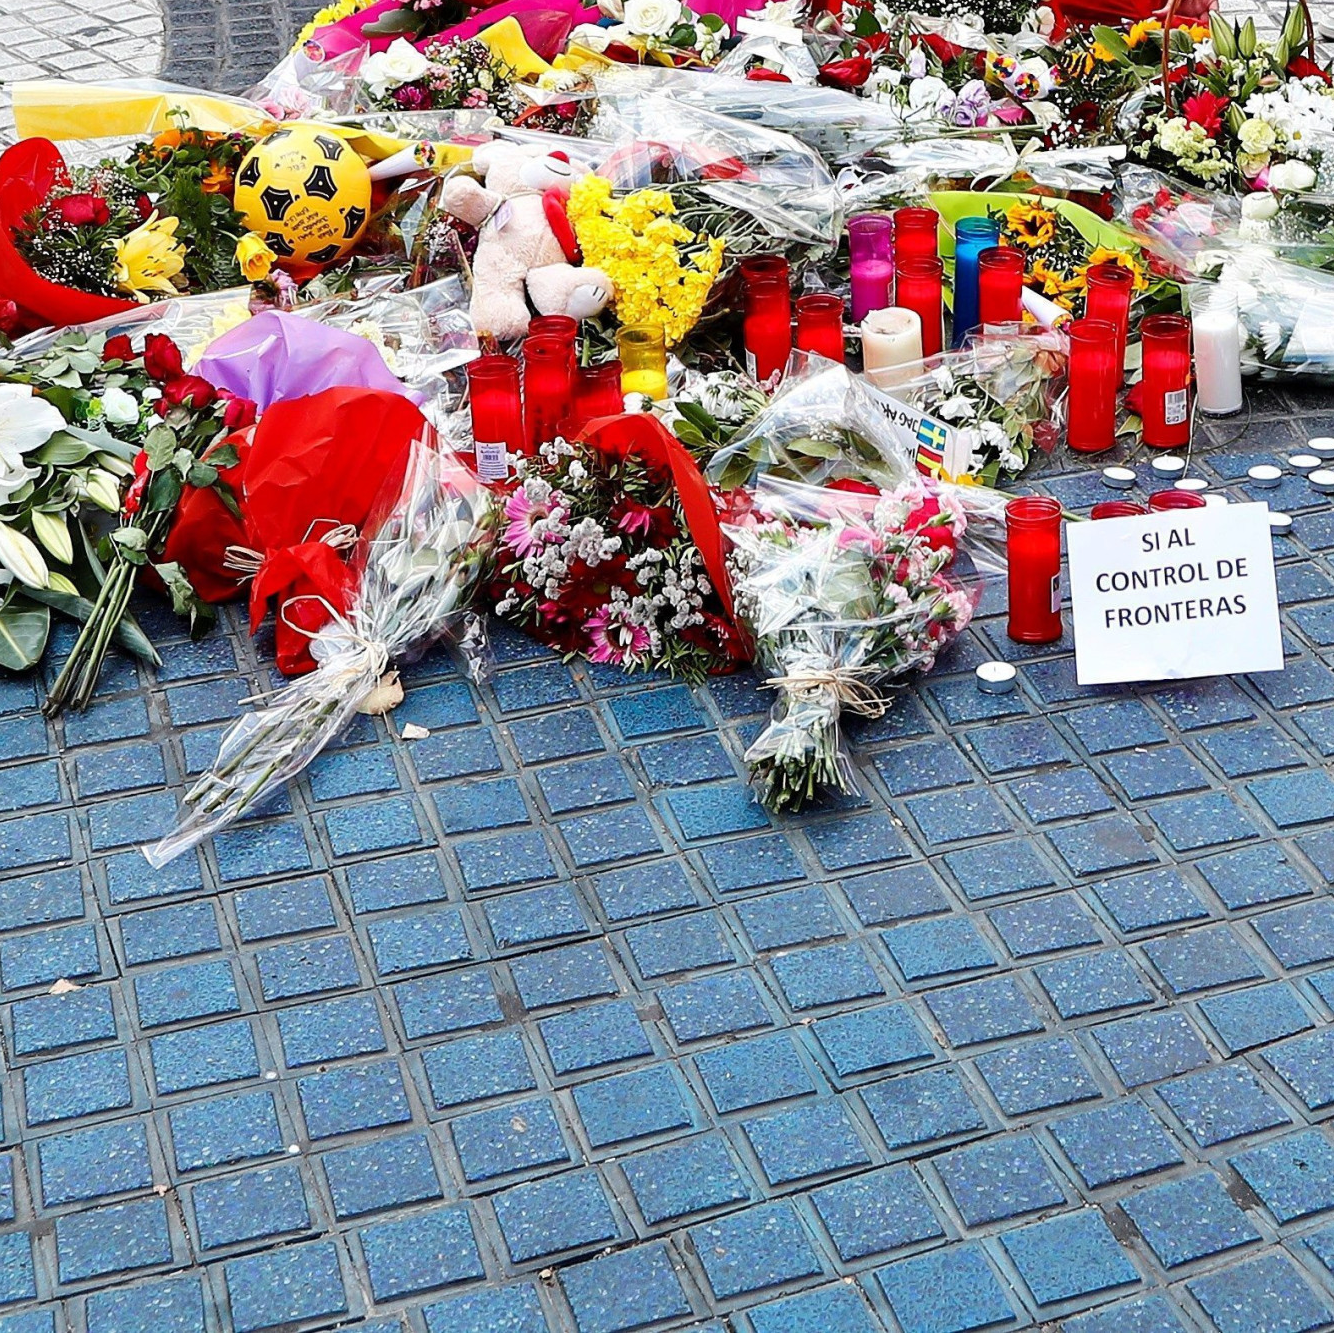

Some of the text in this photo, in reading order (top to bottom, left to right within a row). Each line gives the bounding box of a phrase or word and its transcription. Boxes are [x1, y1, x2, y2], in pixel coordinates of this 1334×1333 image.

[1141, 527, 1196, 553] SI AL
[1095, 557, 1249, 593] CONTROL DE
[1104, 594, 1248, 629] FRONTERAS
